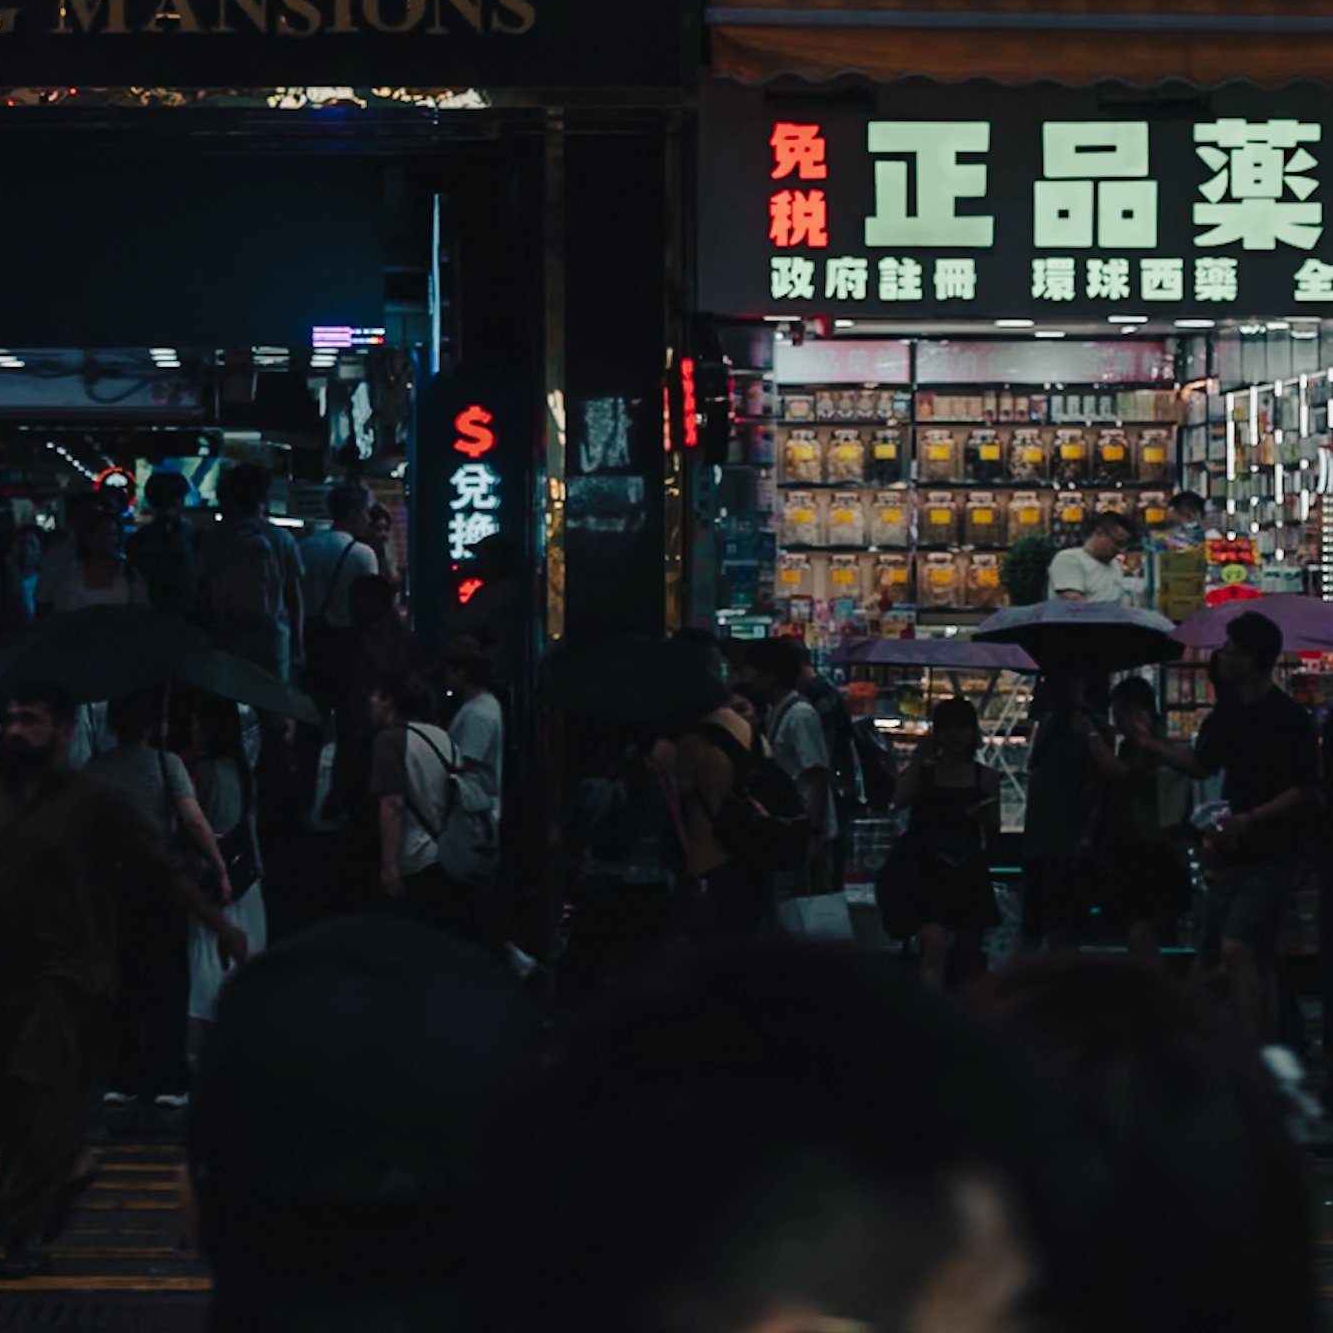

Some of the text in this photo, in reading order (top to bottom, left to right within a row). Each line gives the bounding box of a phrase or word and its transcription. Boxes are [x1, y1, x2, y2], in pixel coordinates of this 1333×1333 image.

[770, 256, 978, 302] 政府註冊
[1032, 256, 1239, 302] 環球西藥
